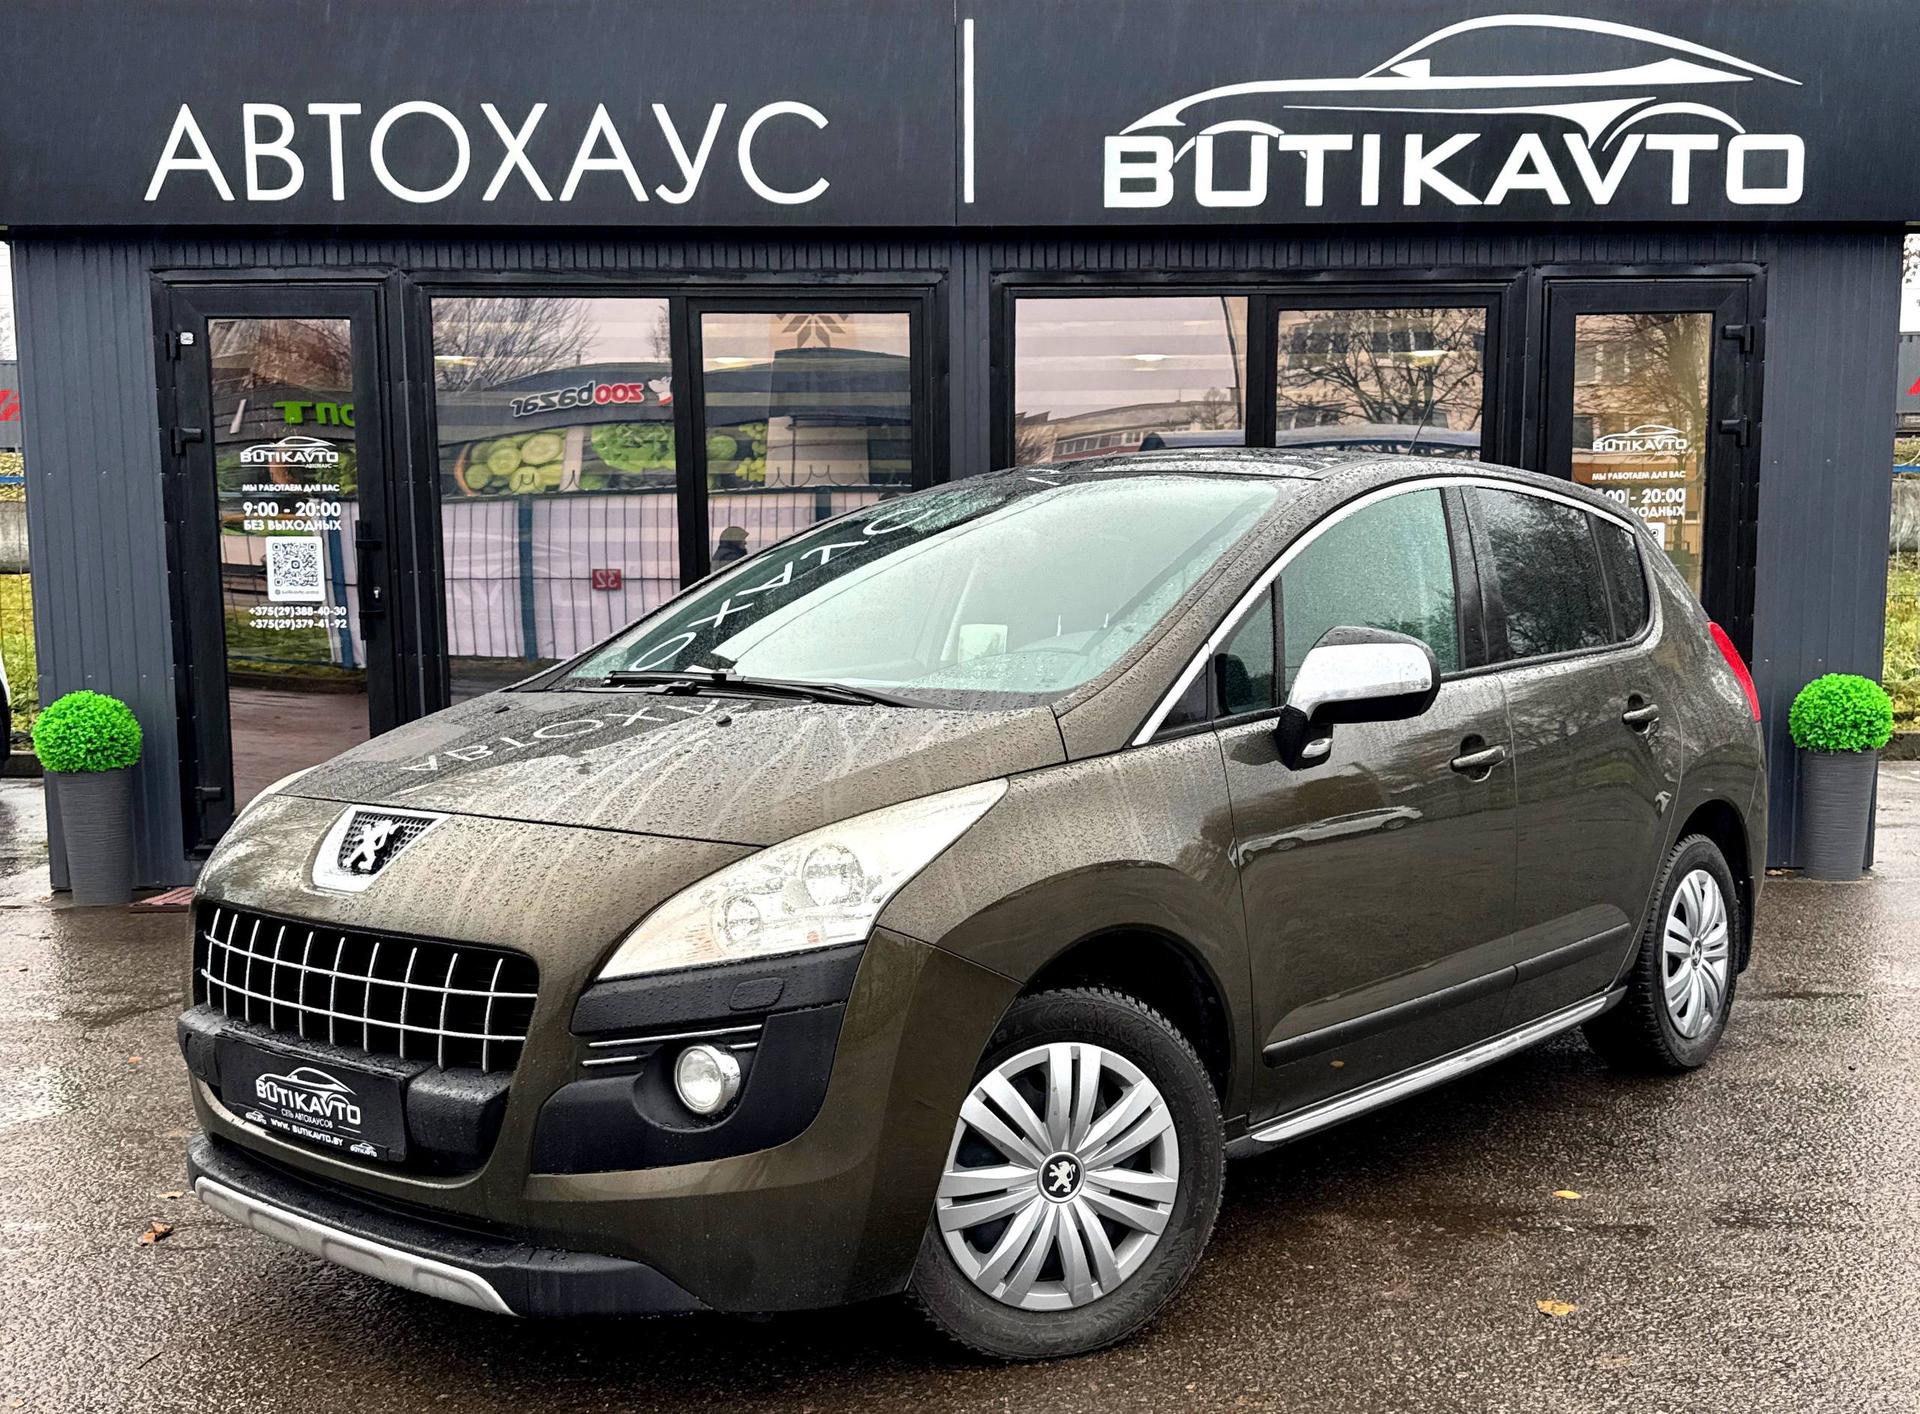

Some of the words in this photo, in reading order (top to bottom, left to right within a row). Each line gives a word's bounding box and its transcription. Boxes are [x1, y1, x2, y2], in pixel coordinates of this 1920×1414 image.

[144, 101, 831, 204] АВТОХАУС
[1104, 132, 1806, 208] BUTIKAVTO
[1592, 439, 1688, 452] BUTIKAVTO
[240, 451, 339, 463] BUTIKAVTO
[1608, 471, 1649, 480] РАБОТАЕМ
[1651, 471, 1667, 479] ДЛЯ
[1669, 470, 1686, 478] ВАС
[242, 484, 257, 492] МЫ
[259, 484, 302, 492] РАБОТАЕМ
[304, 484, 320, 492] ДЛЯ
[322, 484, 340, 492] ВАС
[1641, 488, 1685, 504] 20:00
[243, 502, 279, 517] 9:00
[295, 502, 341, 517] 20:00
[243, 520, 264, 530] БЕЗ
[267, 519, 342, 532] ВЫХОДНЫХ
[249, 606, 347, 617] +375(29)388-40-30
[249, 619, 347, 630] +375(29)379-41-92
[256, 1079, 361, 1125] BUTIKAVTO
